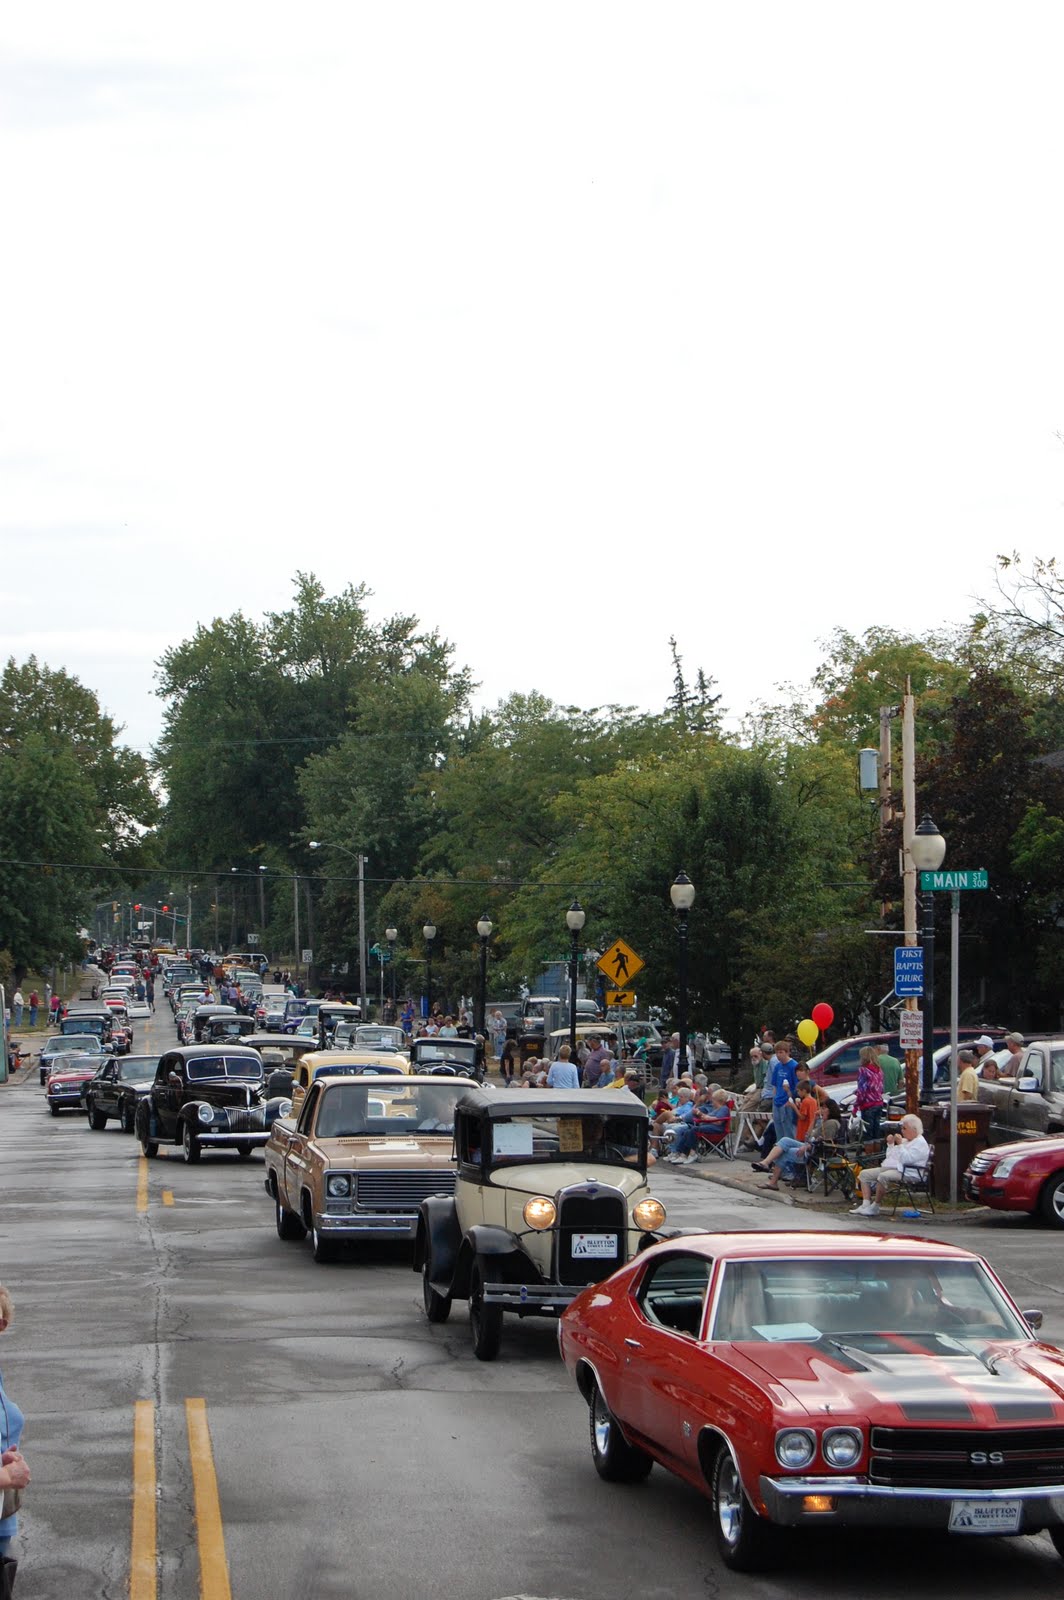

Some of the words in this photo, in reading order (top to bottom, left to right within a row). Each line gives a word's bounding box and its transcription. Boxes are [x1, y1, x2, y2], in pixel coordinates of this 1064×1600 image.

[925, 874, 930, 882] S
[933, 873, 968, 888] MAIN
[972, 880, 988, 888] 300
[901, 950, 923, 958] FIRST
[896, 962, 923, 970] BAPTIS
[896, 974, 923, 982] CHURC
[970, 1451, 1004, 1464] SS
